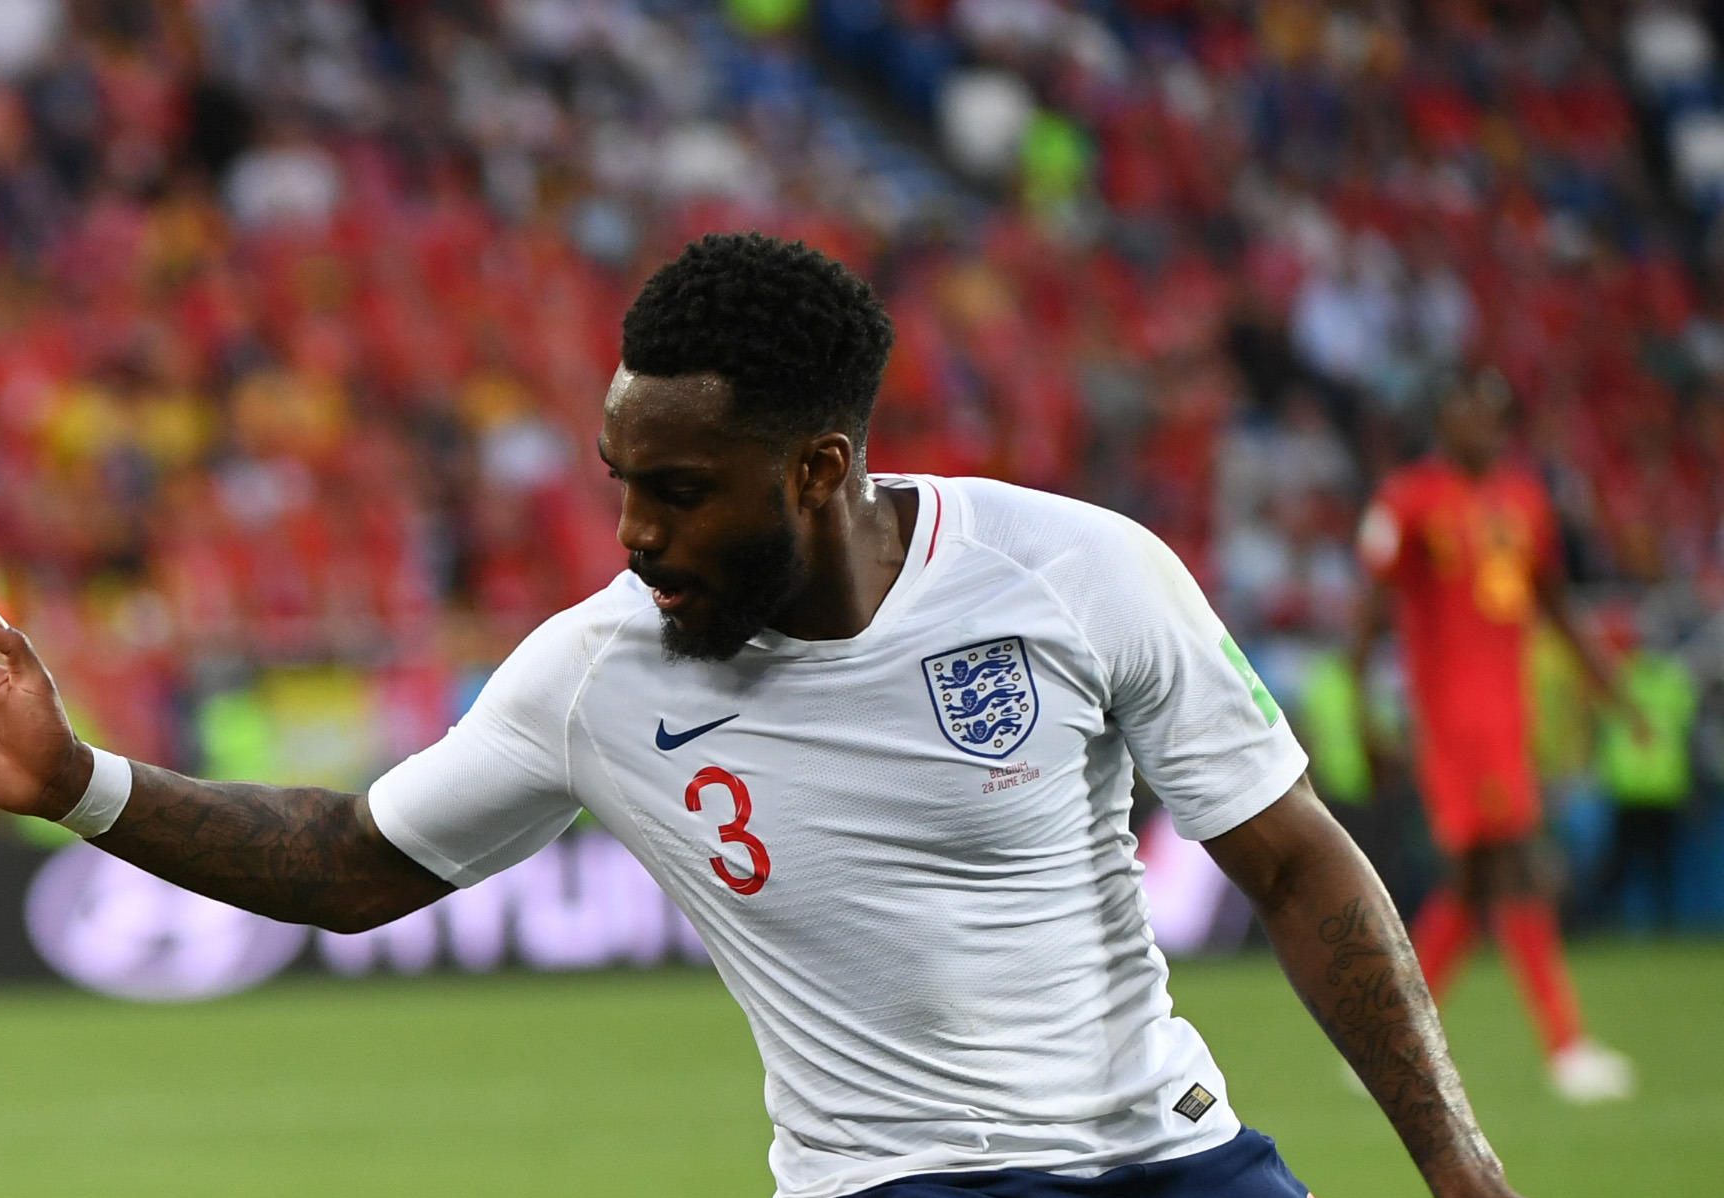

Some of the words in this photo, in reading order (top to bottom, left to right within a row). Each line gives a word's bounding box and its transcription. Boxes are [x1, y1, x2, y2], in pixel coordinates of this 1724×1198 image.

[981, 781, 995, 795] 28
[997, 776, 1019, 791] JUNE
[1021, 768, 1040, 785] 2018
[989, 761, 1029, 779] BELGIUM
[684, 766, 771, 896] 3
